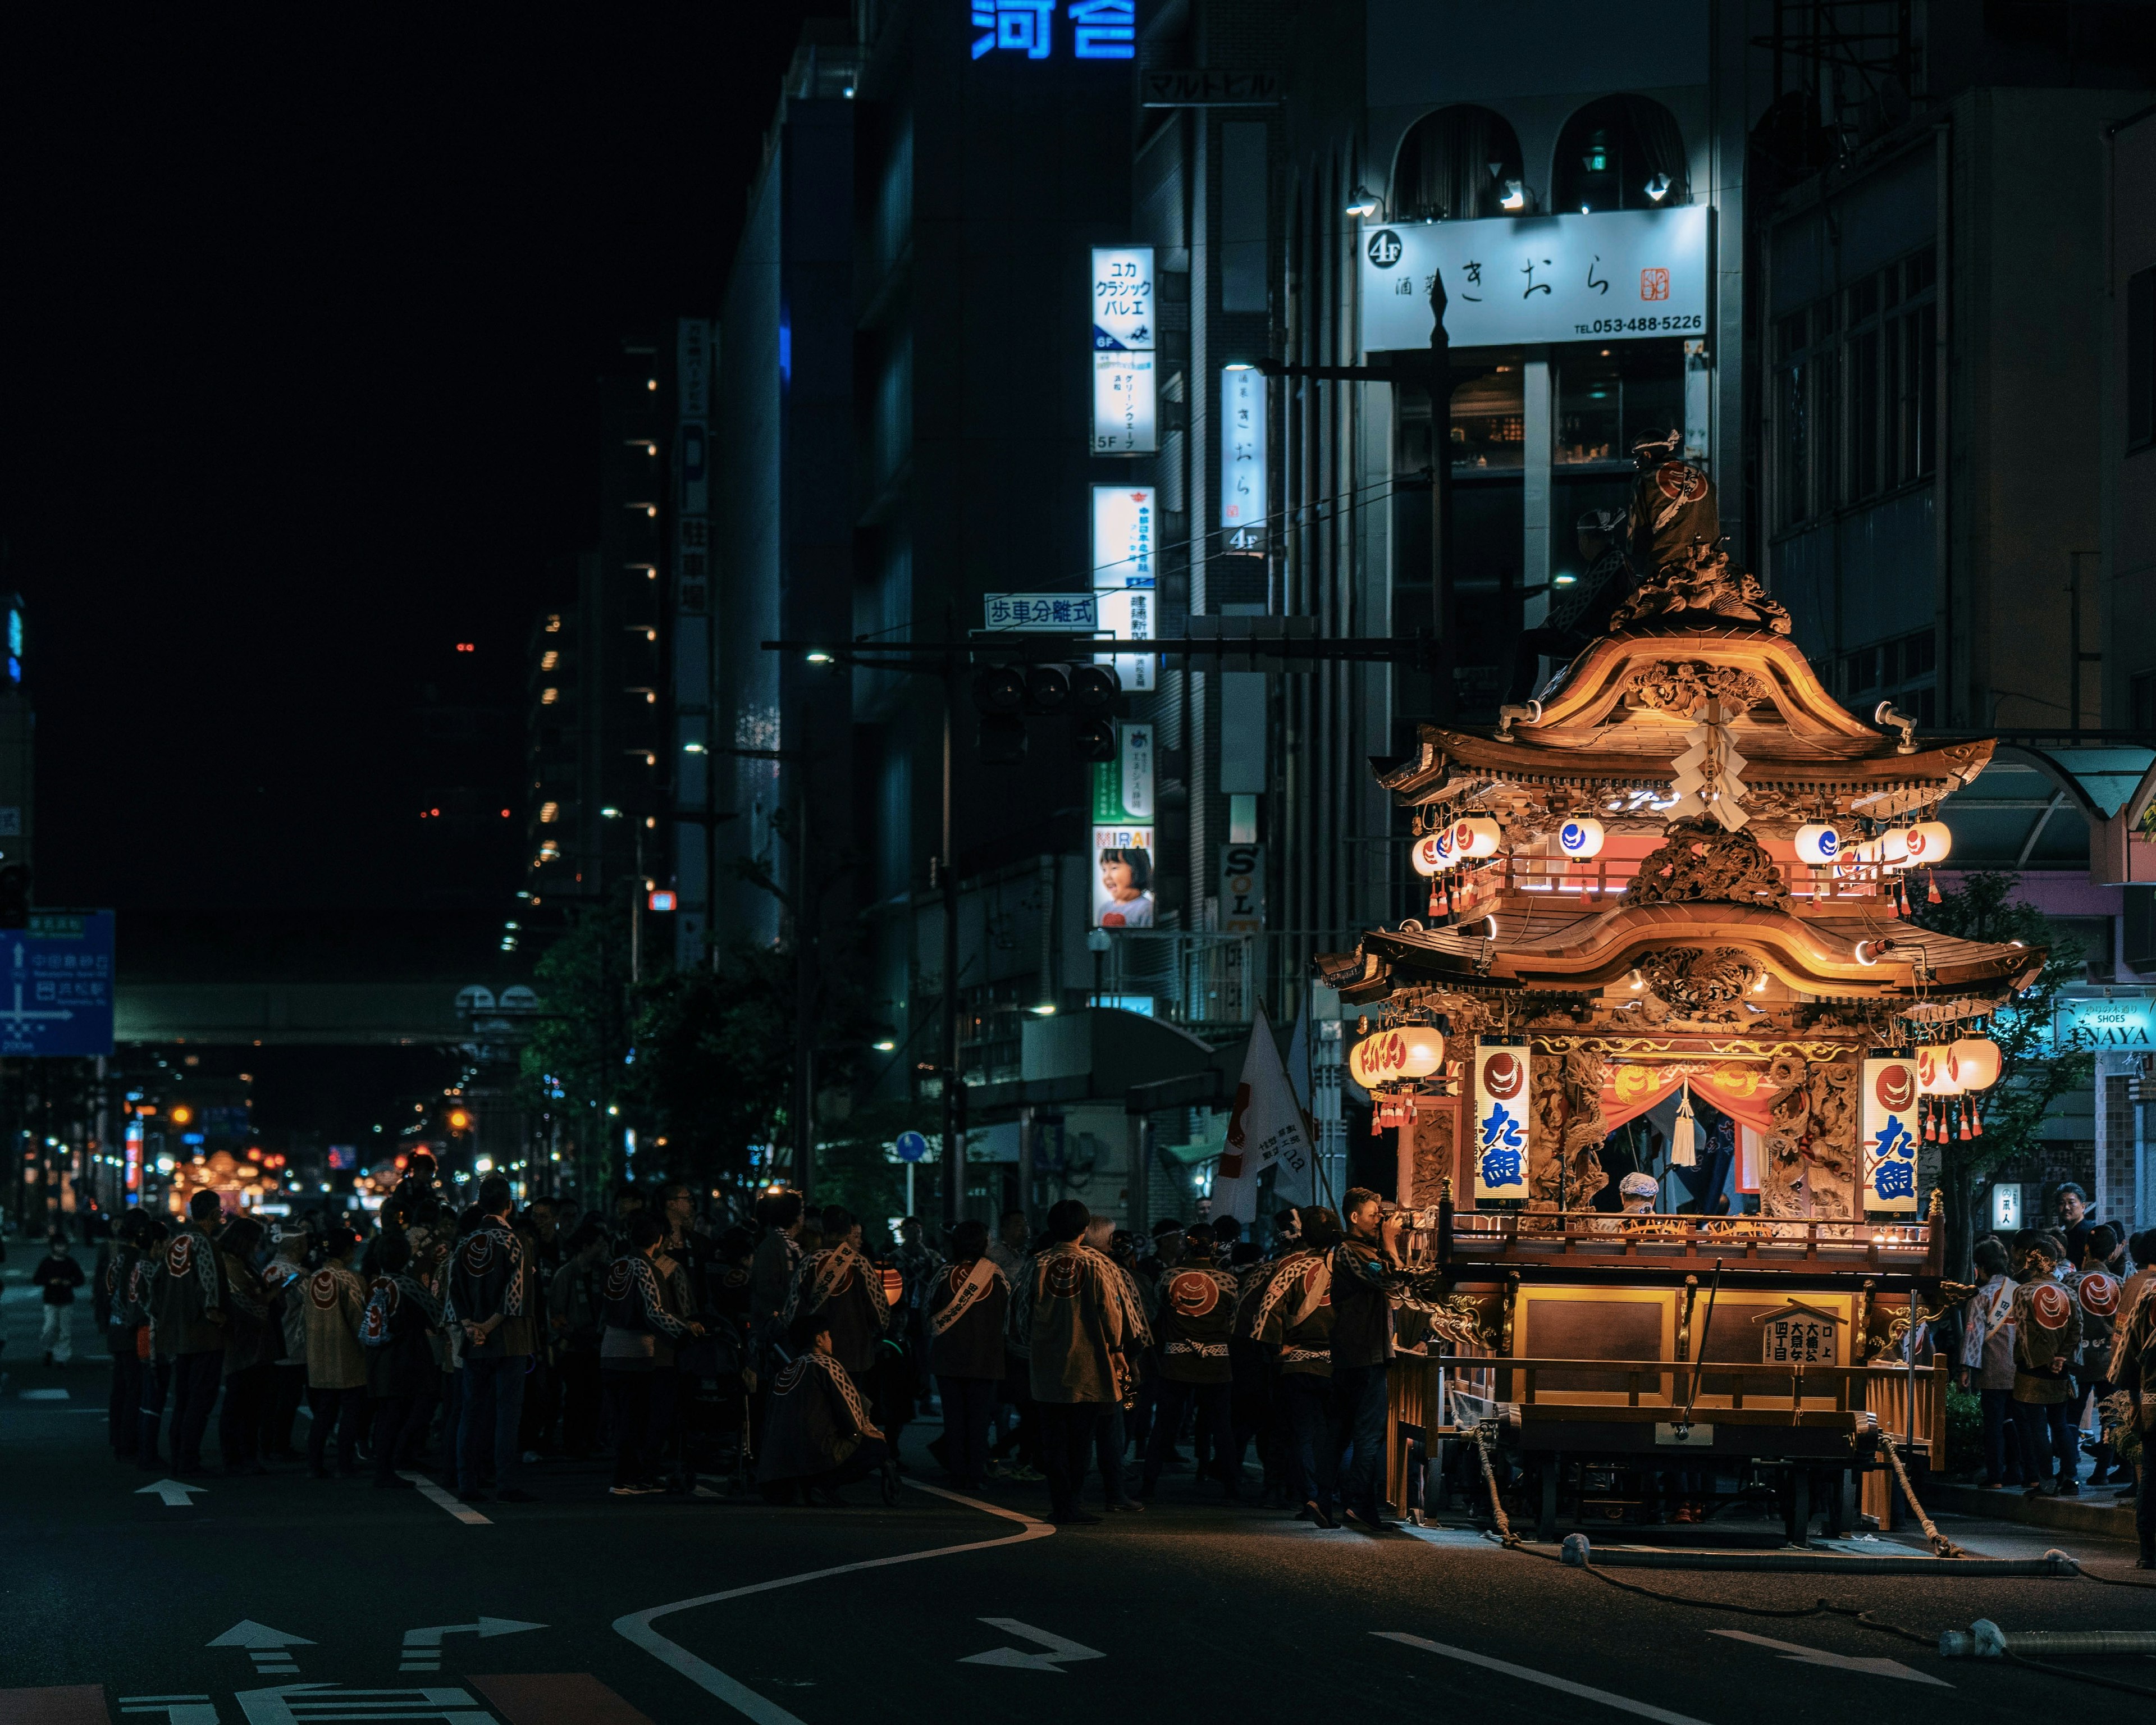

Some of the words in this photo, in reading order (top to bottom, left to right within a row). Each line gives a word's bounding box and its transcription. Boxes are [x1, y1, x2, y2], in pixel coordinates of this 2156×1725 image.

[1111, 262, 1136, 277] ユカ
[1462, 254, 1609, 302] きおら
[1096, 280, 1150, 296] クラシック
[1104, 300, 1144, 315] バレエ
[1096, 337, 1114, 347] 6F
[1097, 437, 1117, 448] 5F
[991, 600, 1091, 623] 歩車分離式
[1096, 831, 1150, 847] MIRAI
[1774, 1321, 1788, 1361] 四丁目
[1822, 1326, 1832, 1357] 口上
